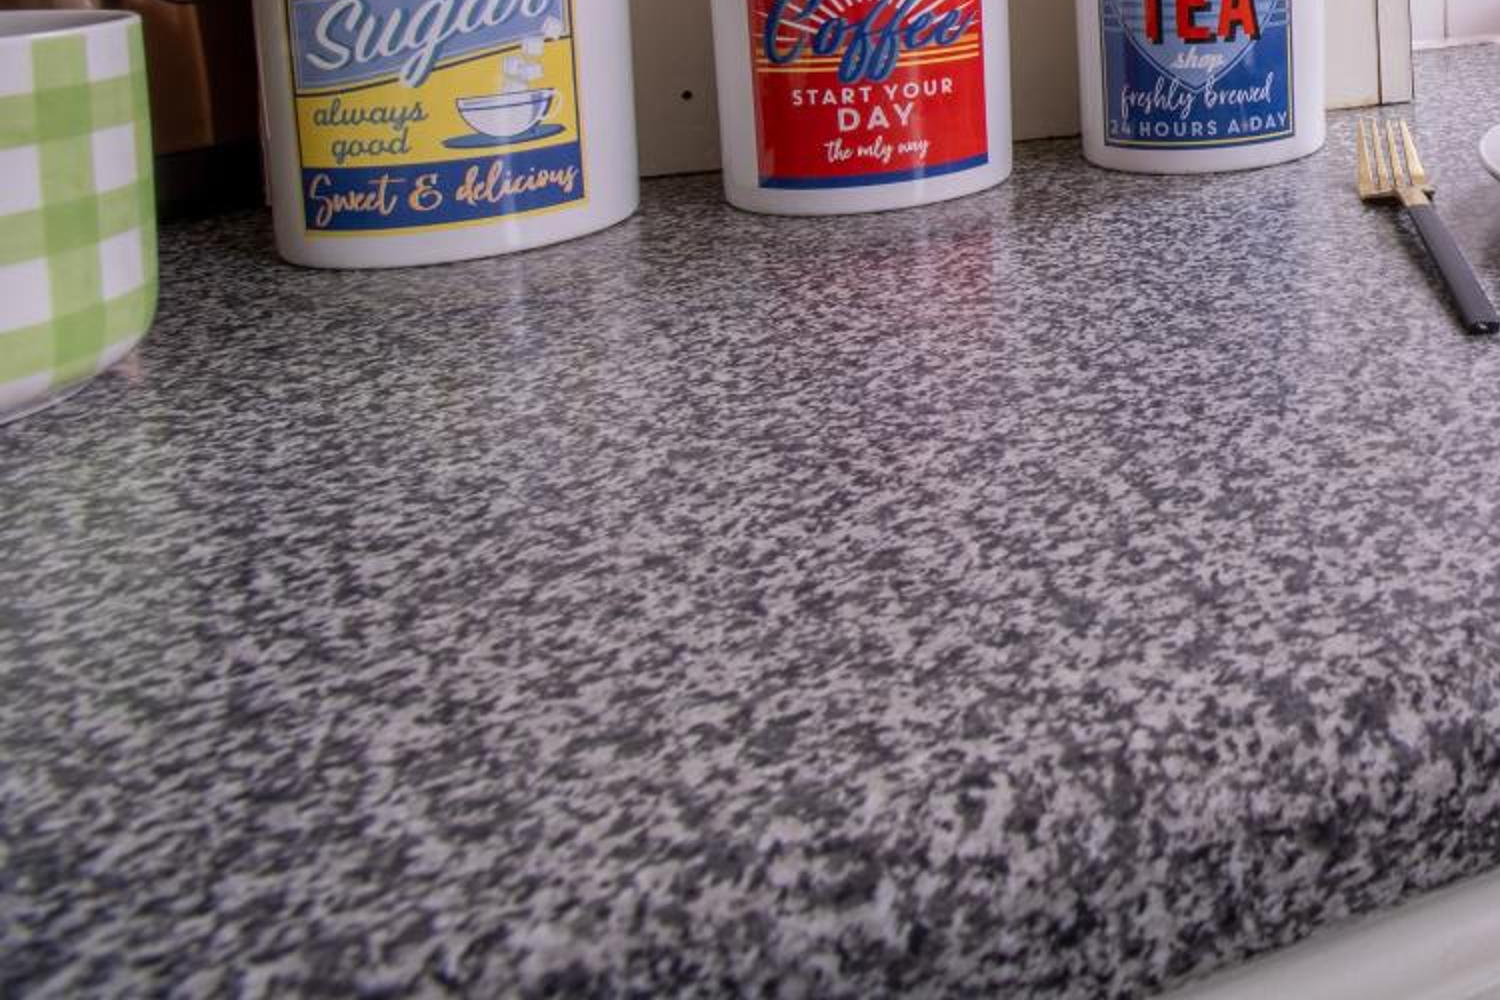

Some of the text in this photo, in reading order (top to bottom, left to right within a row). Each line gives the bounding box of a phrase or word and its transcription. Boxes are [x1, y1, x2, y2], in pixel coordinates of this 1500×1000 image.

[1169, 49, 1227, 74] shop
[792, 77, 953, 106] START YOUR
[1121, 72, 1274, 120] freshly brewed
[313, 98, 428, 131] always
[838, 103, 915, 132] DAY
[1111, 119, 1131, 136] 24
[1139, 119, 1217, 138] HOURS
[332, 127, 411, 164] good
[825, 136, 929, 164] the only way
[309, 160, 579, 227] Sweet & delicious
